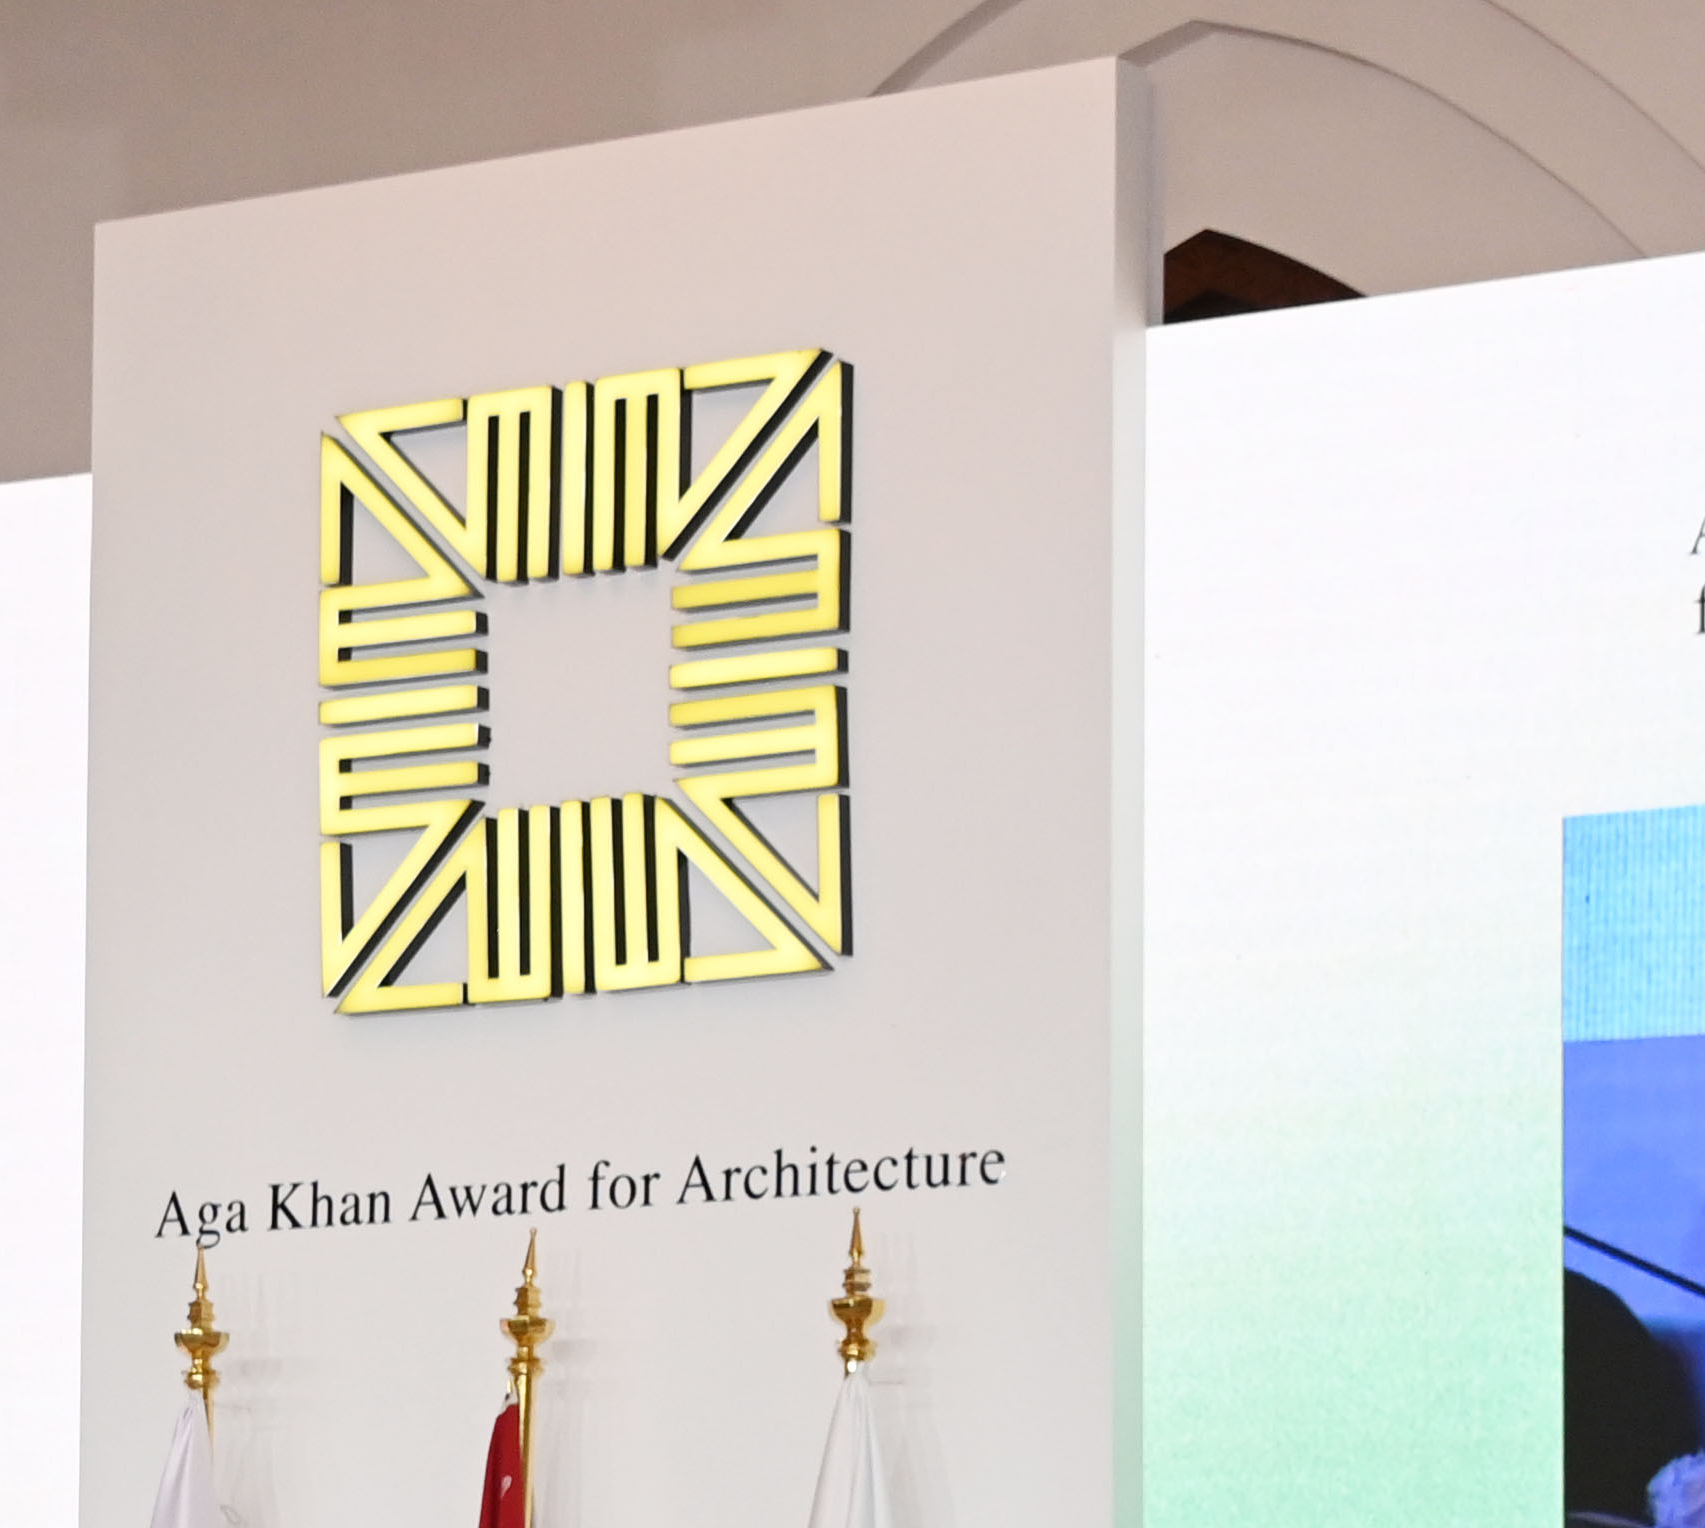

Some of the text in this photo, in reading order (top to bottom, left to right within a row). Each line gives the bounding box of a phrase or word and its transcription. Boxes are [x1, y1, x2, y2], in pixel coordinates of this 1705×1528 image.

[154, 1144, 1006, 1249] Aga Khan Award for Architecture
